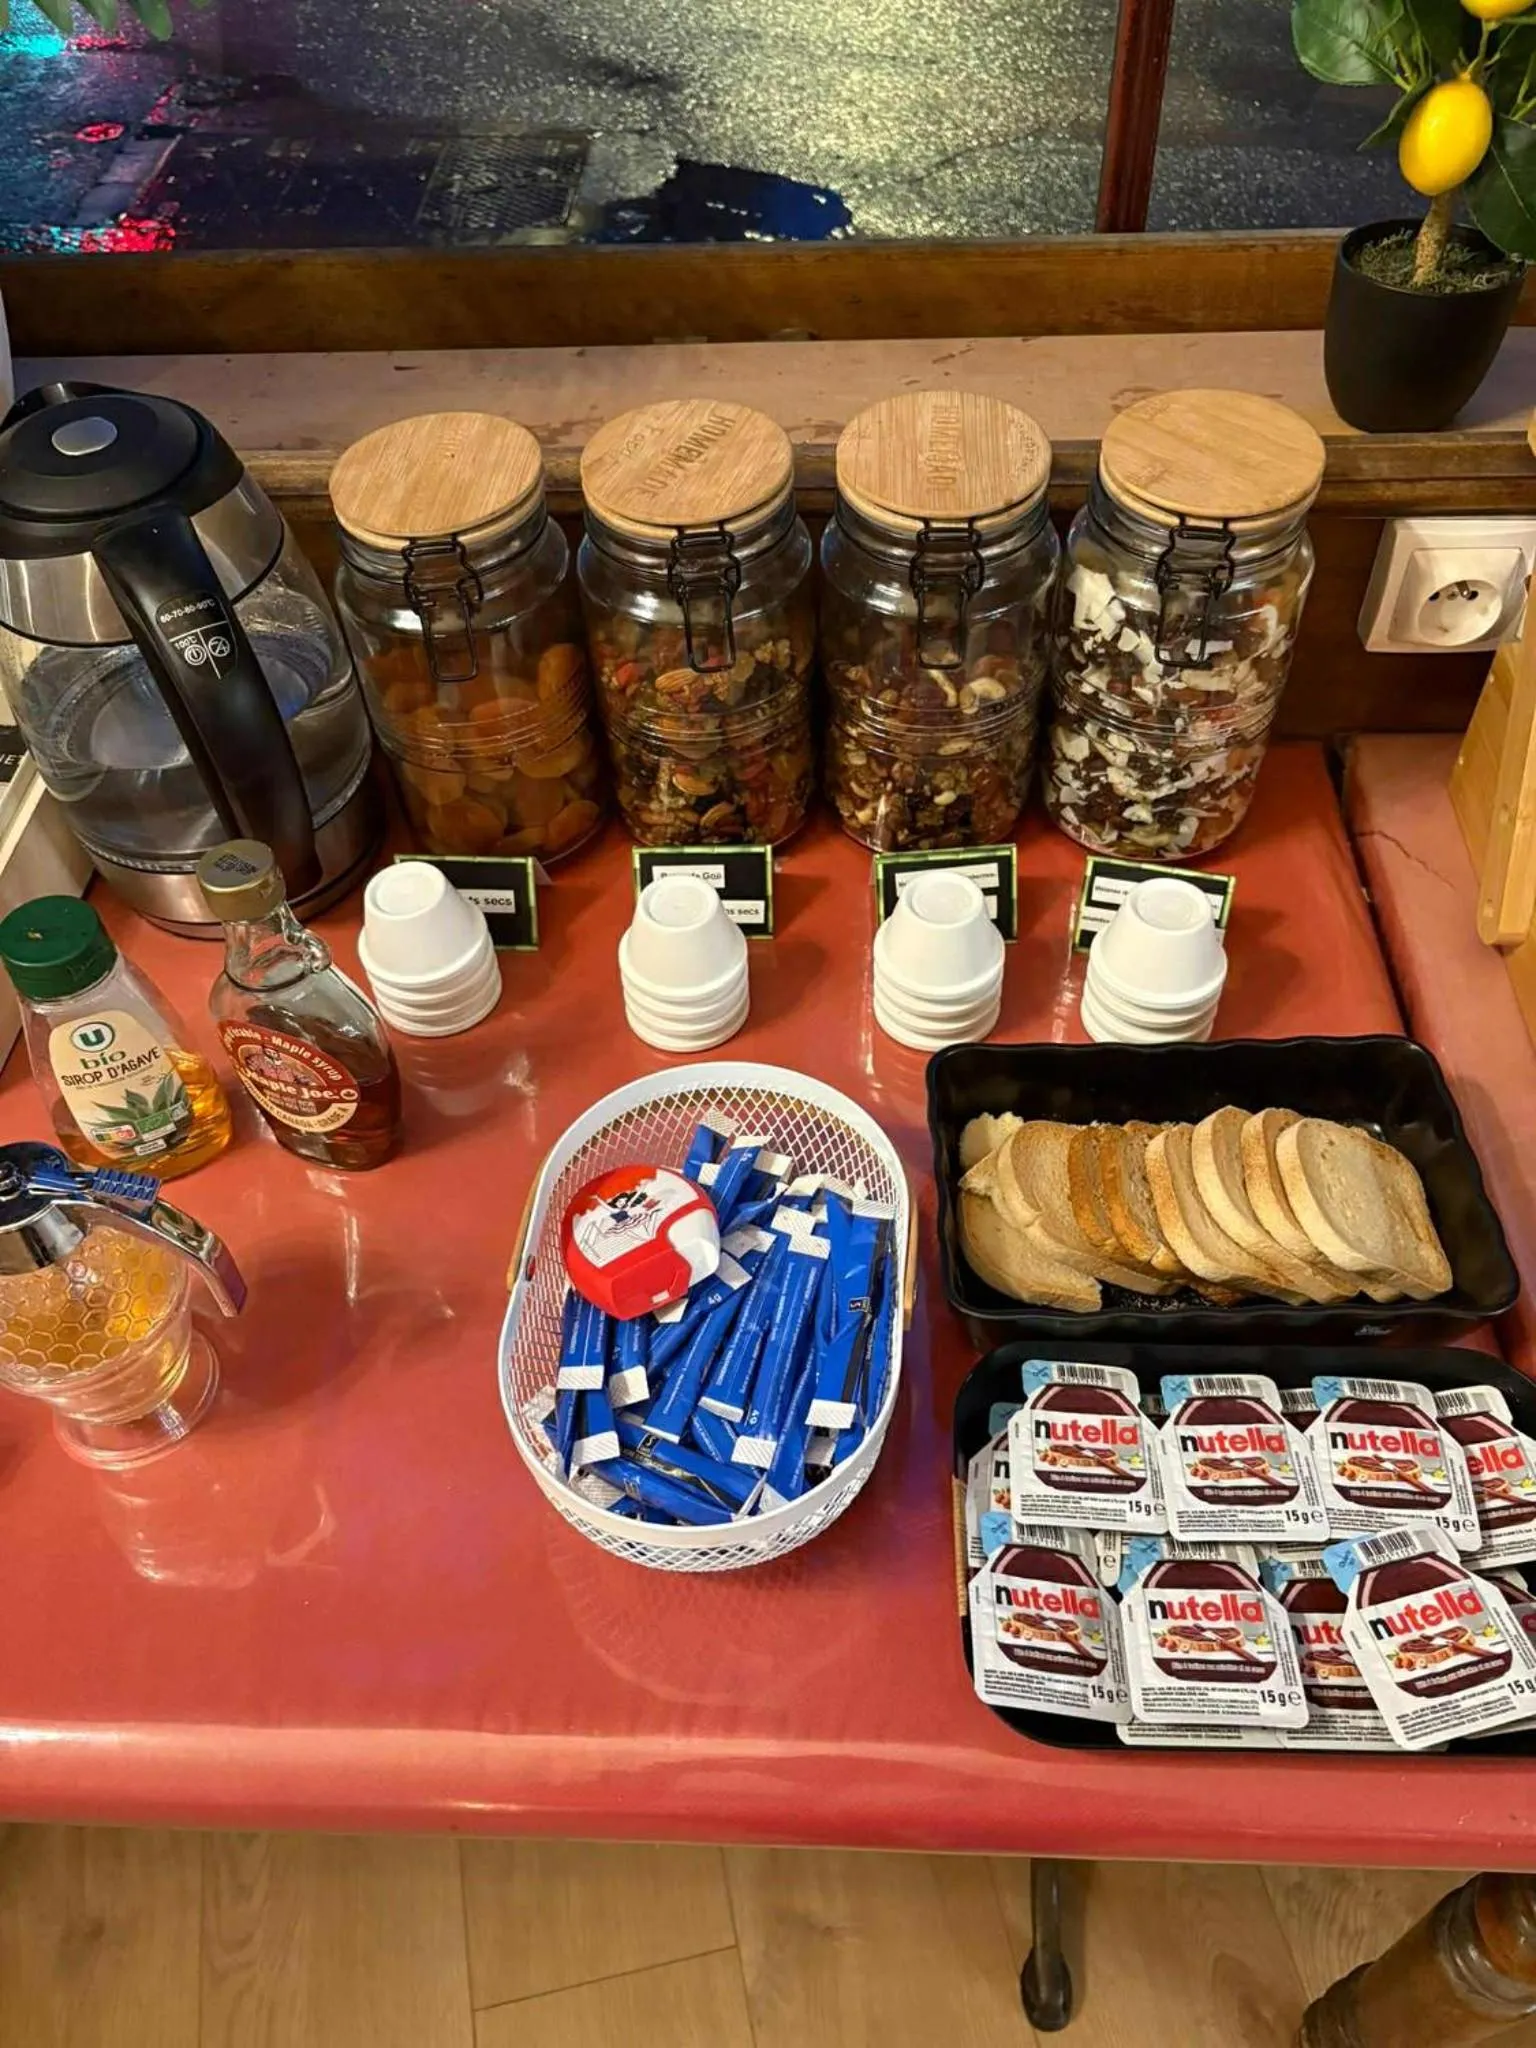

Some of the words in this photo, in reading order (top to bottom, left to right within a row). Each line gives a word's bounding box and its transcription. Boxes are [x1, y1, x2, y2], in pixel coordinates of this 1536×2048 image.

[642, 413, 736, 498] HOMEMADE
[79, 1028, 105, 1047] U
[61, 1071, 104, 1087] SIROP
[107, 1046, 161, 1079] D'AGAVE
[80, 1050, 126, 1070] bio
[271, 1035, 312, 1060] Maple
[312, 1054, 343, 1081] syrup
[300, 1087, 340, 1099] Joe
[1034, 1418, 1139, 1445] nutella
[1180, 1427, 1287, 1453] nutella
[1330, 1430, 1442, 1457] nutella
[1466, 1445, 1526, 1475] ella
[995, 1585, 1101, 1619] nutella
[1148, 1594, 1264, 1622] nutella
[1368, 1588, 1485, 1640] nutella
